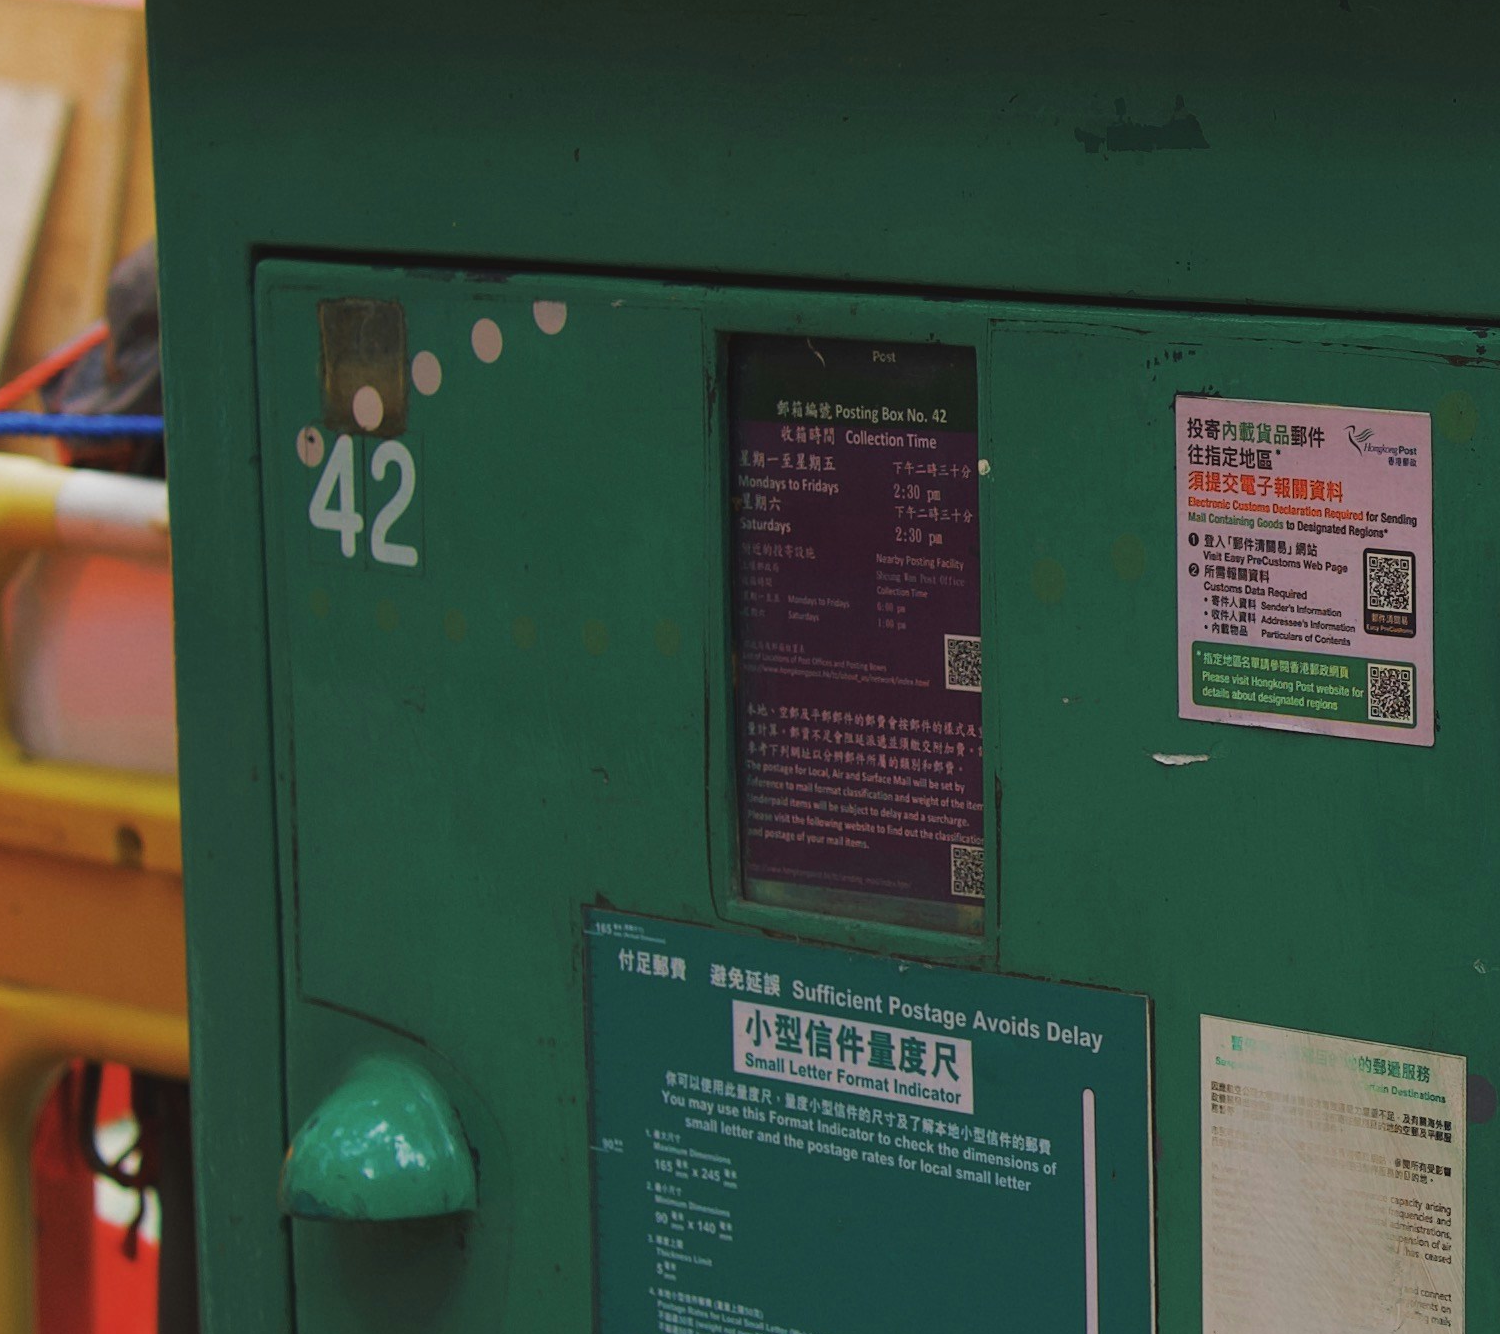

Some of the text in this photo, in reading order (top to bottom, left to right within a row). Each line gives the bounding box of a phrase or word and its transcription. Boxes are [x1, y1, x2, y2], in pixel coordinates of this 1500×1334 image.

[872, 351, 896, 363] Post
[776, 400, 948, 424] 郵箱編號 Posting Box No. 42
[780, 425, 938, 449] 收箱時間 Collection Time
[1187, 417, 1325, 449] 投寄內載貨品郵件
[739, 450, 972, 479] 星期一至星期五 下午二時三十分
[1398, 445, 1418, 456] Post
[309, 434, 418, 568] 42
[738, 475, 941, 503] Mondays to Fridays 2:30 pm
[1187, 471, 1343, 503] 須提交電子報關資料
[741, 493, 973, 524] 星期六 下午二時三十分
[1188, 496, 1417, 527] Electronic Customs Declaration Required for Sending
[740, 518, 943, 546] Saturdays 2:30 pm
[1188, 512, 1206, 523] Mail
[1208, 513, 1255, 528] Containing
[1257, 516, 1284, 529] Goods
[1286, 520, 1295, 531] to
[1297, 521, 1346, 536] Designated
[1203, 550, 1348, 574] Visit Easy PreCustoms Web Page
[1204, 565, 1270, 583] 所需報關資料
[1203, 581, 1308, 600] Customs Data Required
[1261, 629, 1303, 643] Particulars
[1304, 632, 1313, 642] of
[1315, 634, 1351, 646] Contents
[618, 948, 1103, 1053] 付足郵費 避免延誤 Sufficient Postage Avoids Delay
[745, 1009, 959, 1082] 小型信件量度尺
[745, 1052, 962, 1105] Small Letter Format Indicator
[1391, 1084, 1447, 1104] Destinations
